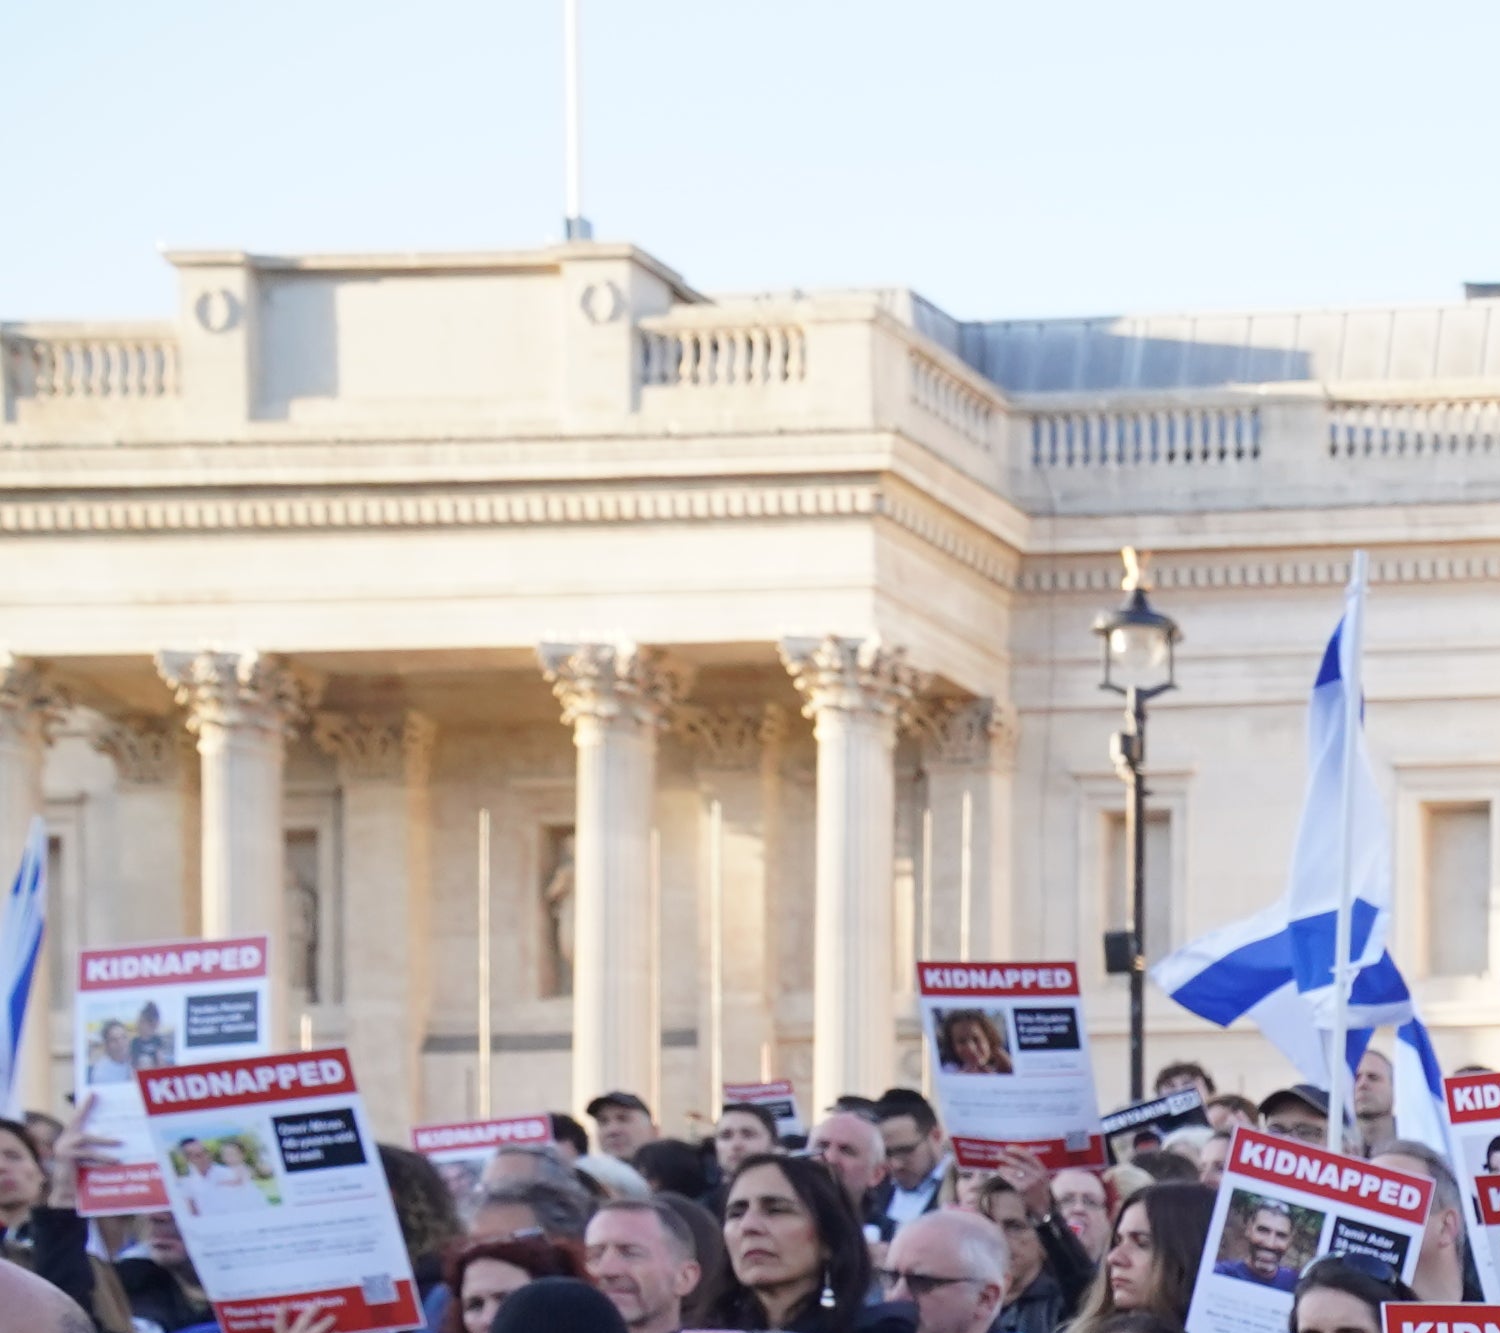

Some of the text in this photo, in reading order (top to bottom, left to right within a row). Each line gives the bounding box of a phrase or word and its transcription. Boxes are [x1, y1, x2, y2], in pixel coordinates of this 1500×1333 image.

[86, 945, 262, 983] KIDNAPPED
[923, 968, 1073, 989] KIDNAPPED
[147, 1057, 346, 1104] KIDNAPPED
[1240, 1141, 1421, 1210] KIDNAPPED
